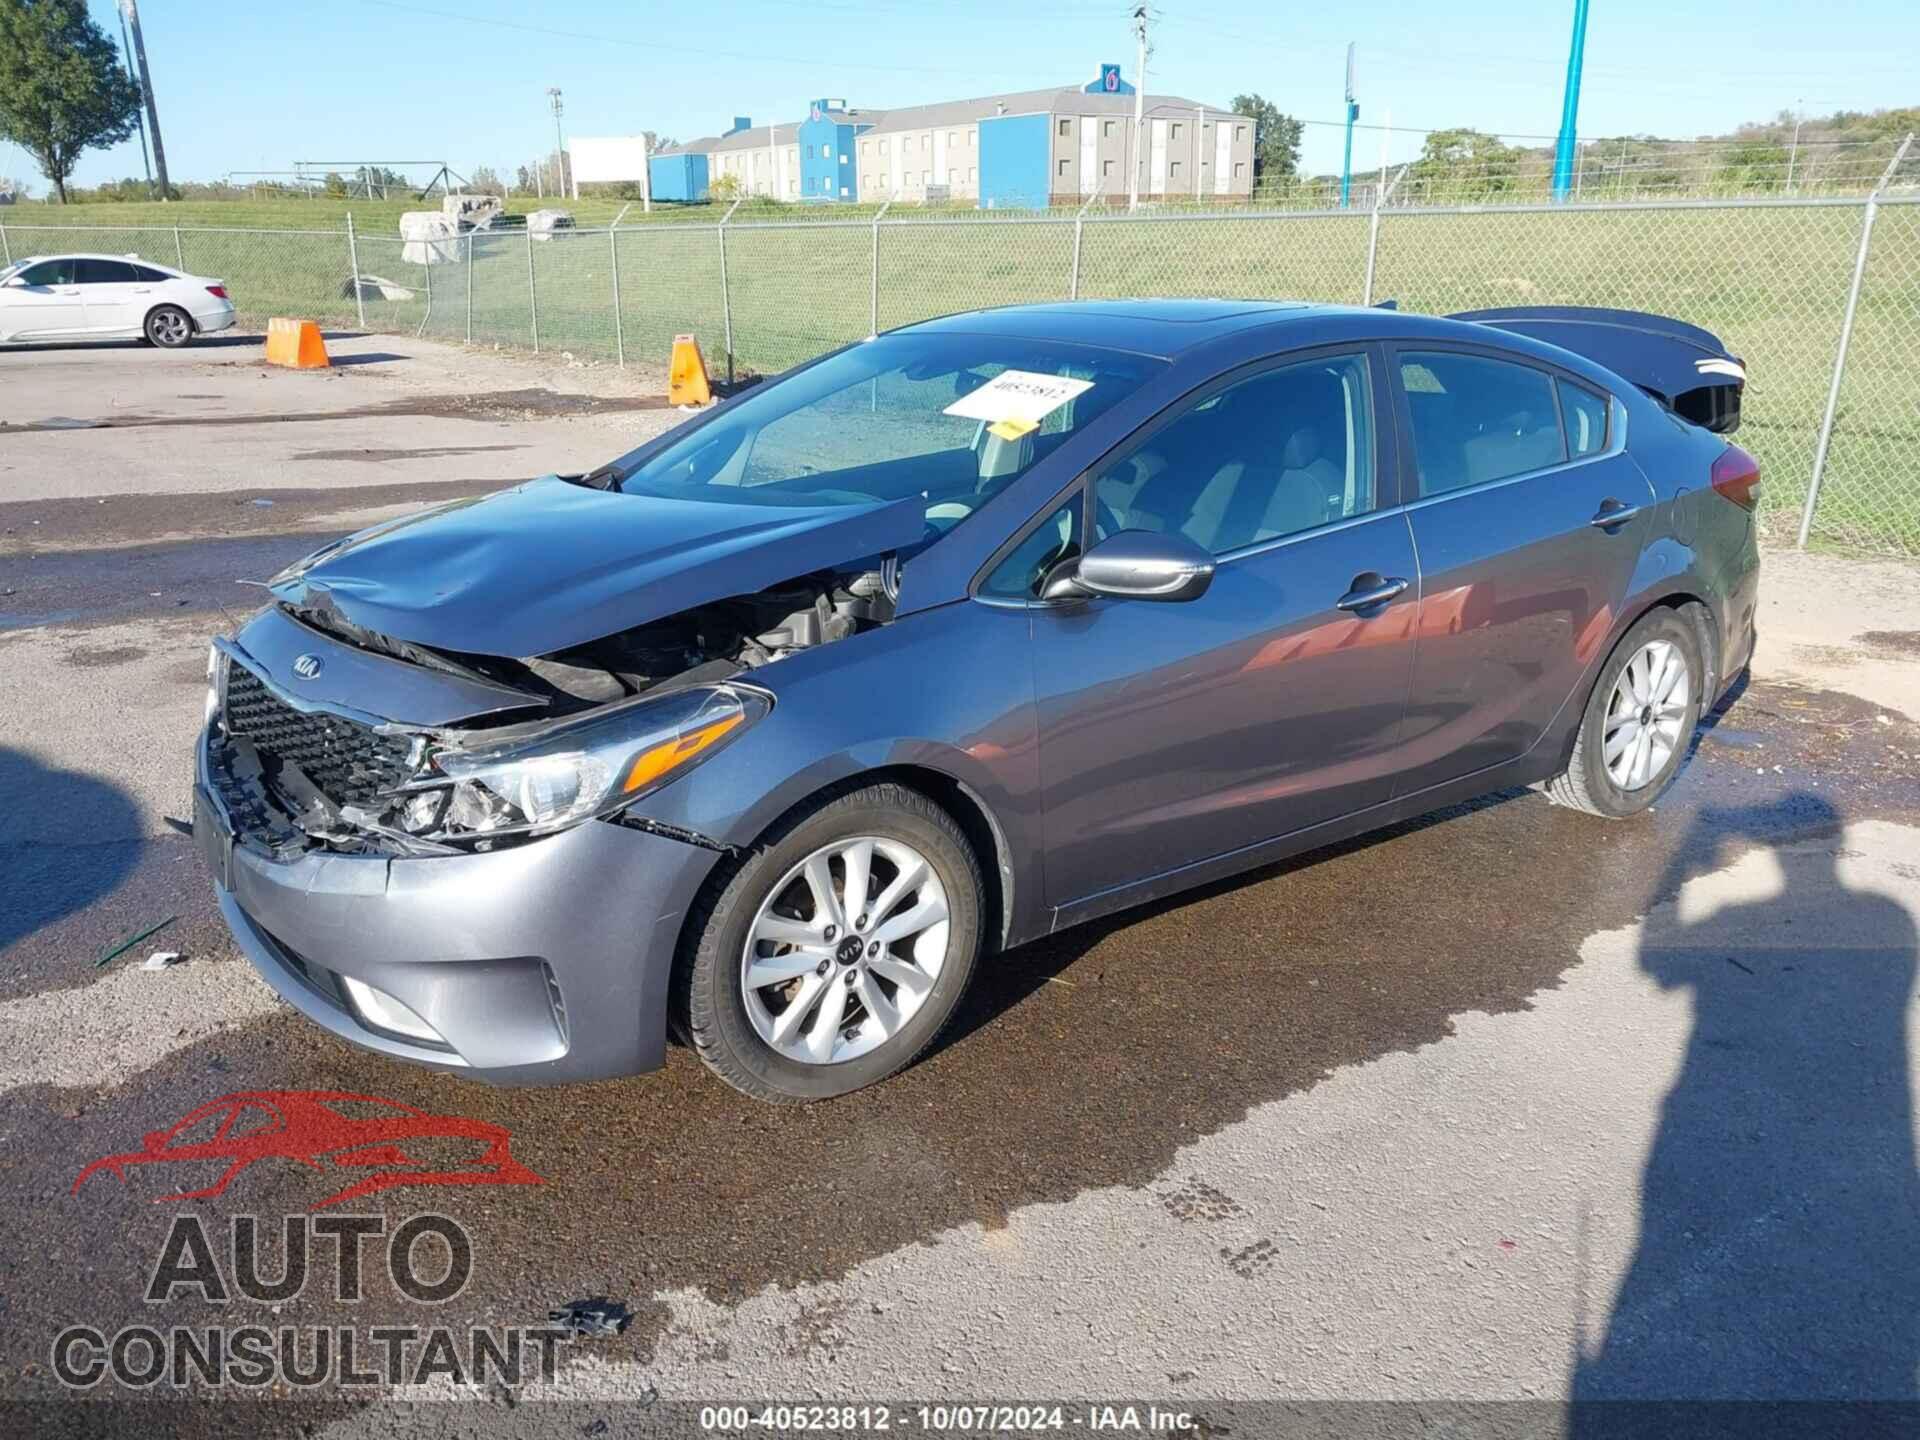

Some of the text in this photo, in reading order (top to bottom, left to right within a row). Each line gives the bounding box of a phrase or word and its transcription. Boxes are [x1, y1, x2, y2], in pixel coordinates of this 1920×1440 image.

[1105, 68, 1119, 91] 6
[294, 655, 318, 677] KIA
[839, 939, 863, 961] KIA
